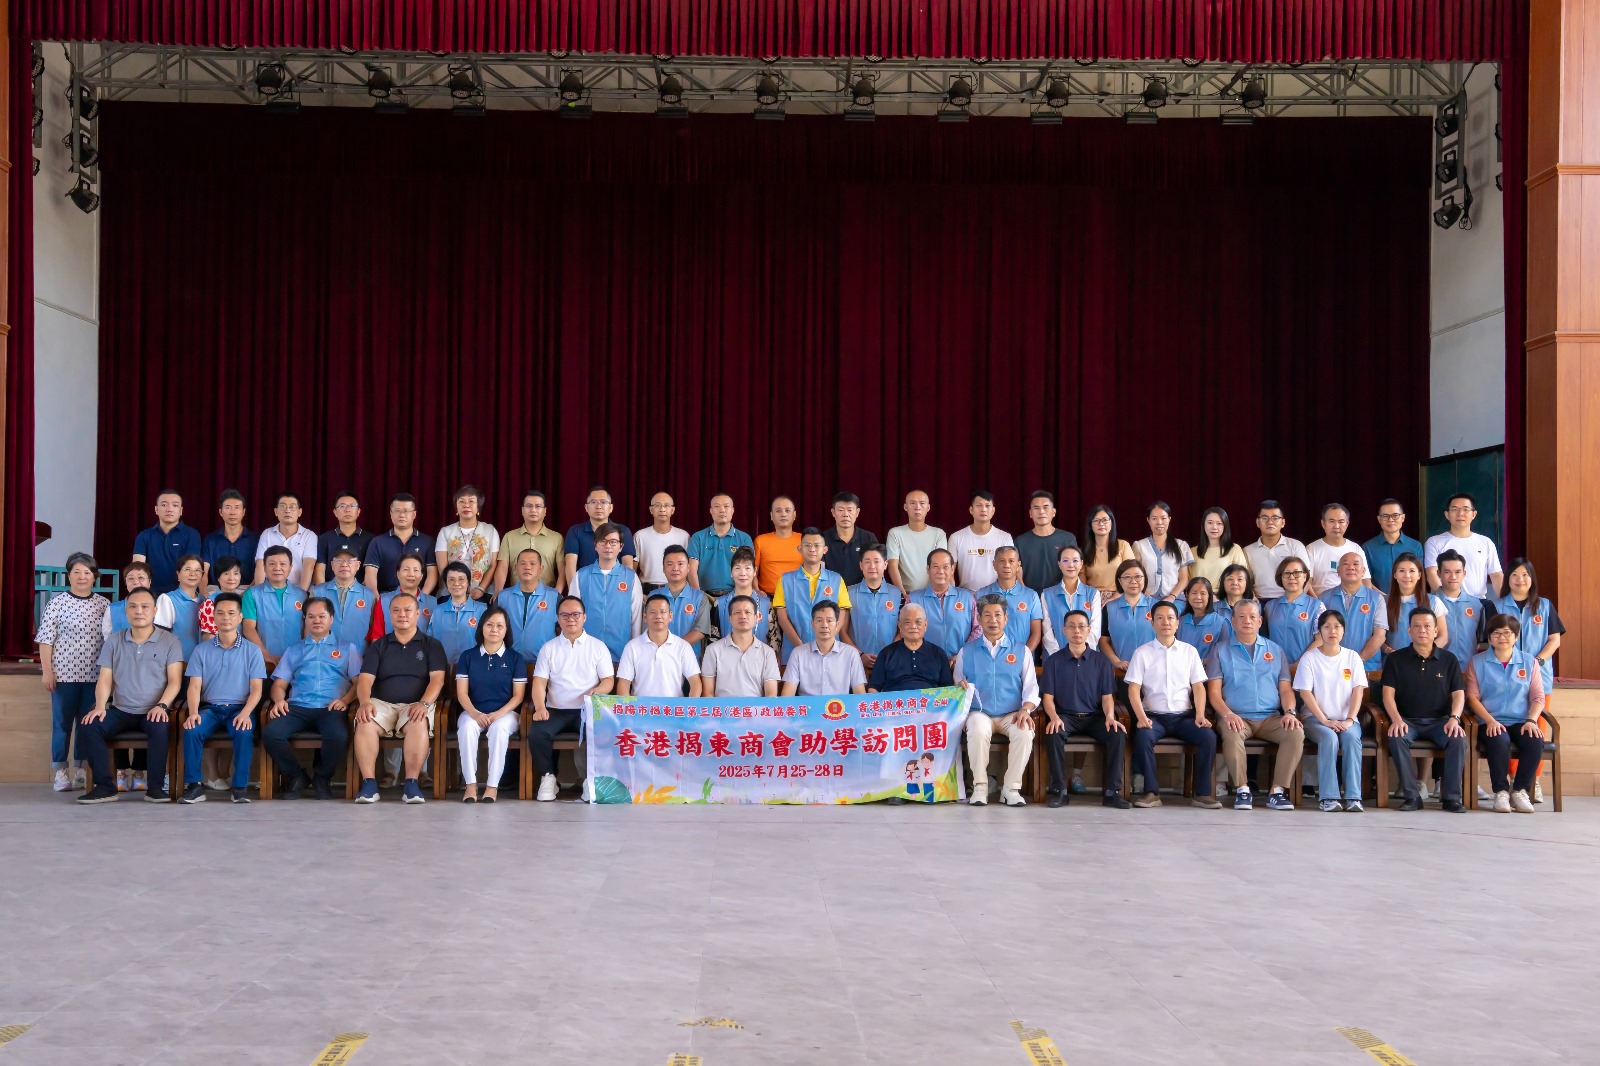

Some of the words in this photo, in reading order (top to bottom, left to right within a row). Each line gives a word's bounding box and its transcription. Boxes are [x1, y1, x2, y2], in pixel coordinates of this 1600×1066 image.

[858, 697, 928, 712] 香港揭東商會
[614, 721, 948, 757] 香港揭東商會助學訪問團
[719, 764, 844, 778] 2025年7月25-28日
